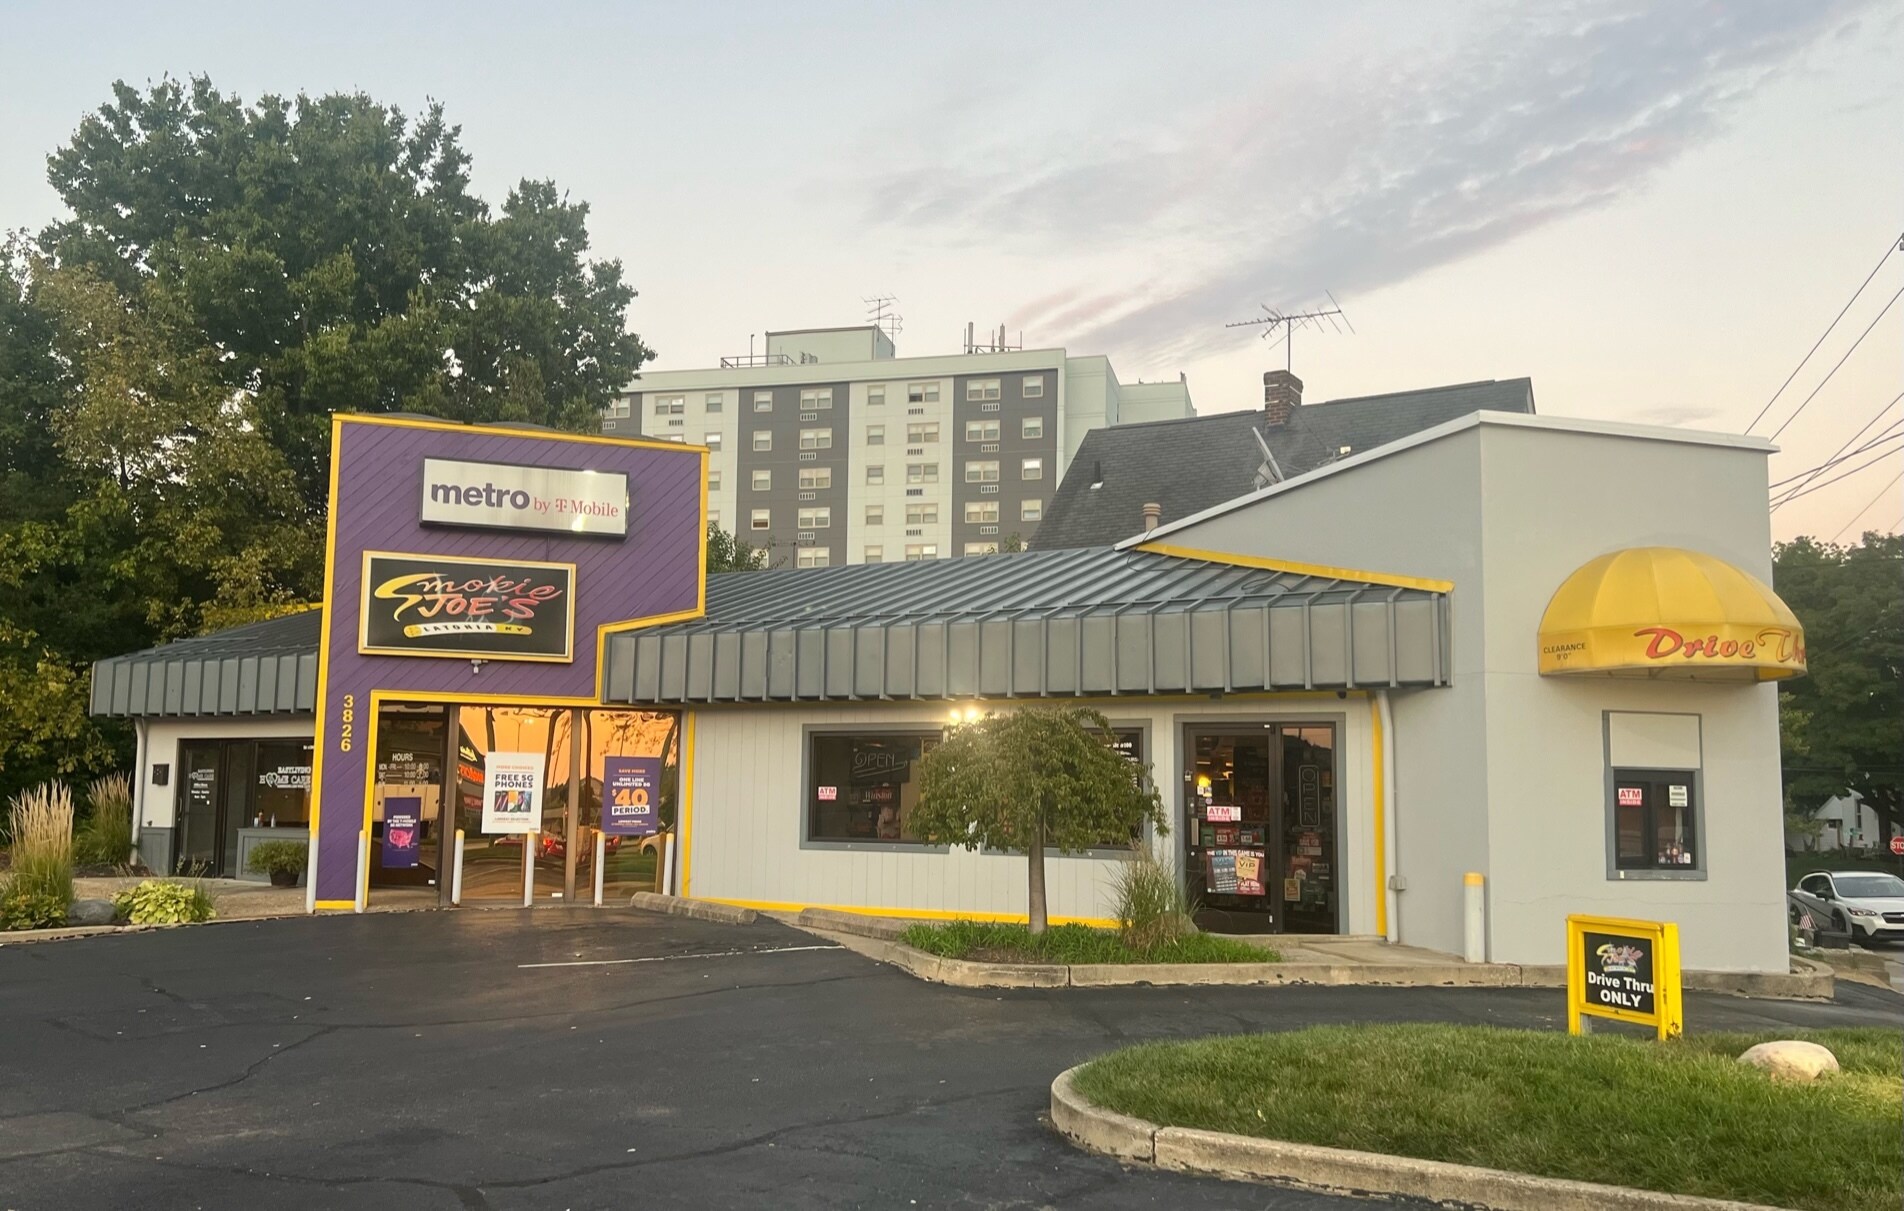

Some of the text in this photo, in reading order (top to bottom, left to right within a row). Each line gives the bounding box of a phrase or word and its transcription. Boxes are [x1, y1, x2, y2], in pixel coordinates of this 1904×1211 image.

[431, 483, 530, 510] metro
[534, 497, 550, 515] by
[570, 499, 619, 517] Mobile
[374, 573, 563, 622] Smokie
[417, 594, 539, 618] JOE'S
[423, 624, 493, 633] LATONIA
[1543, 642, 1587, 654] CLEARANCE
[1634, 627, 1756, 660] Drive
[340, 694, 354, 752] 3826
[392, 753, 413, 761] HOURS
[854, 752, 895, 768] OPEN
[1301, 768, 1317, 822] OPEN
[1620, 789, 1640, 798] ATM
[1208, 807, 1230, 815] ATM
[1588, 971, 1655, 993] Drive Thru
[1600, 989, 1642, 1007] ONLY
